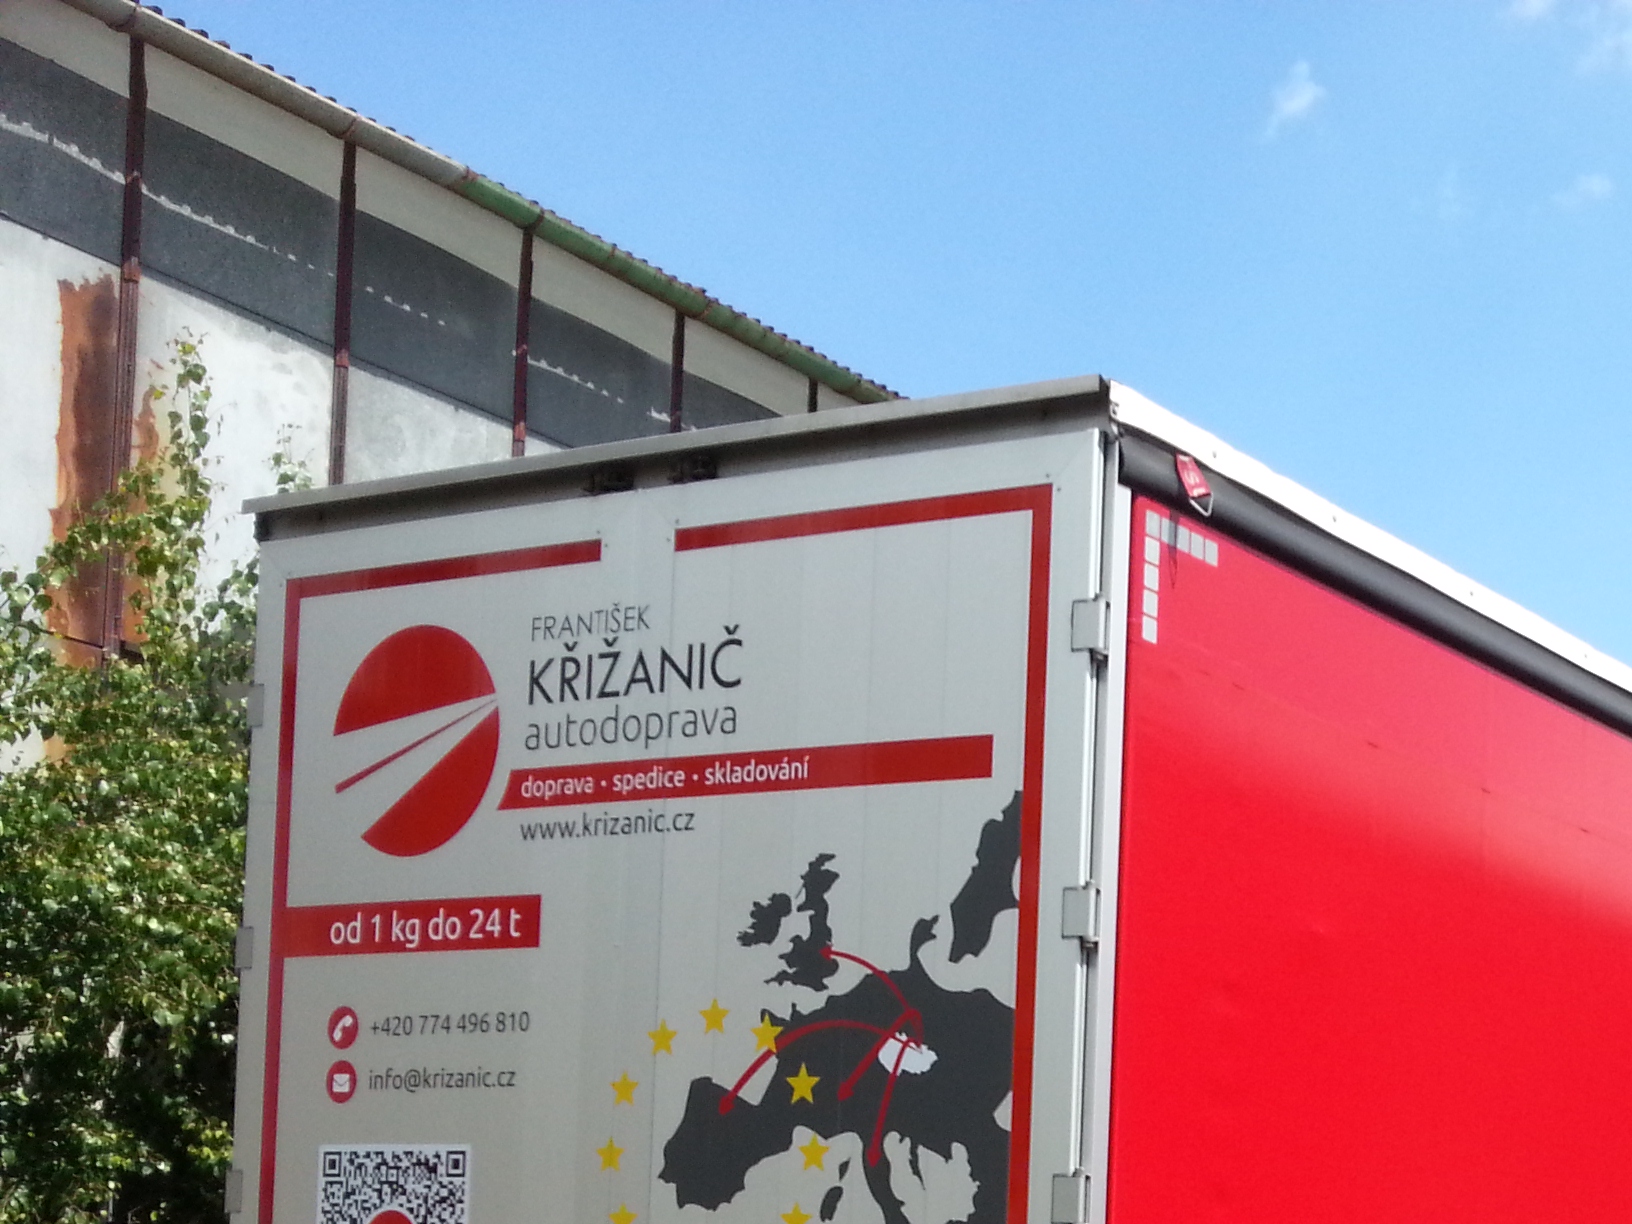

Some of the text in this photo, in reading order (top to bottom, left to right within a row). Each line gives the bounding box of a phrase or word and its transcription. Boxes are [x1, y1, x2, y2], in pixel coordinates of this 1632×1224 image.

[530, 602, 651, 643] FRANTIŠEK
[527, 624, 744, 706] KŘIŽANIČ
[523, 704, 738, 751] autodoprava
[520, 755, 810, 799] doprava spedice skladování
[519, 808, 695, 842] www.krizanic.cz
[329, 907, 522, 949] od 1 kg do 24 t
[369, 1010, 531, 1037] +420 774 496 810
[368, 1065, 517, 1093] info@krizanic.cz
